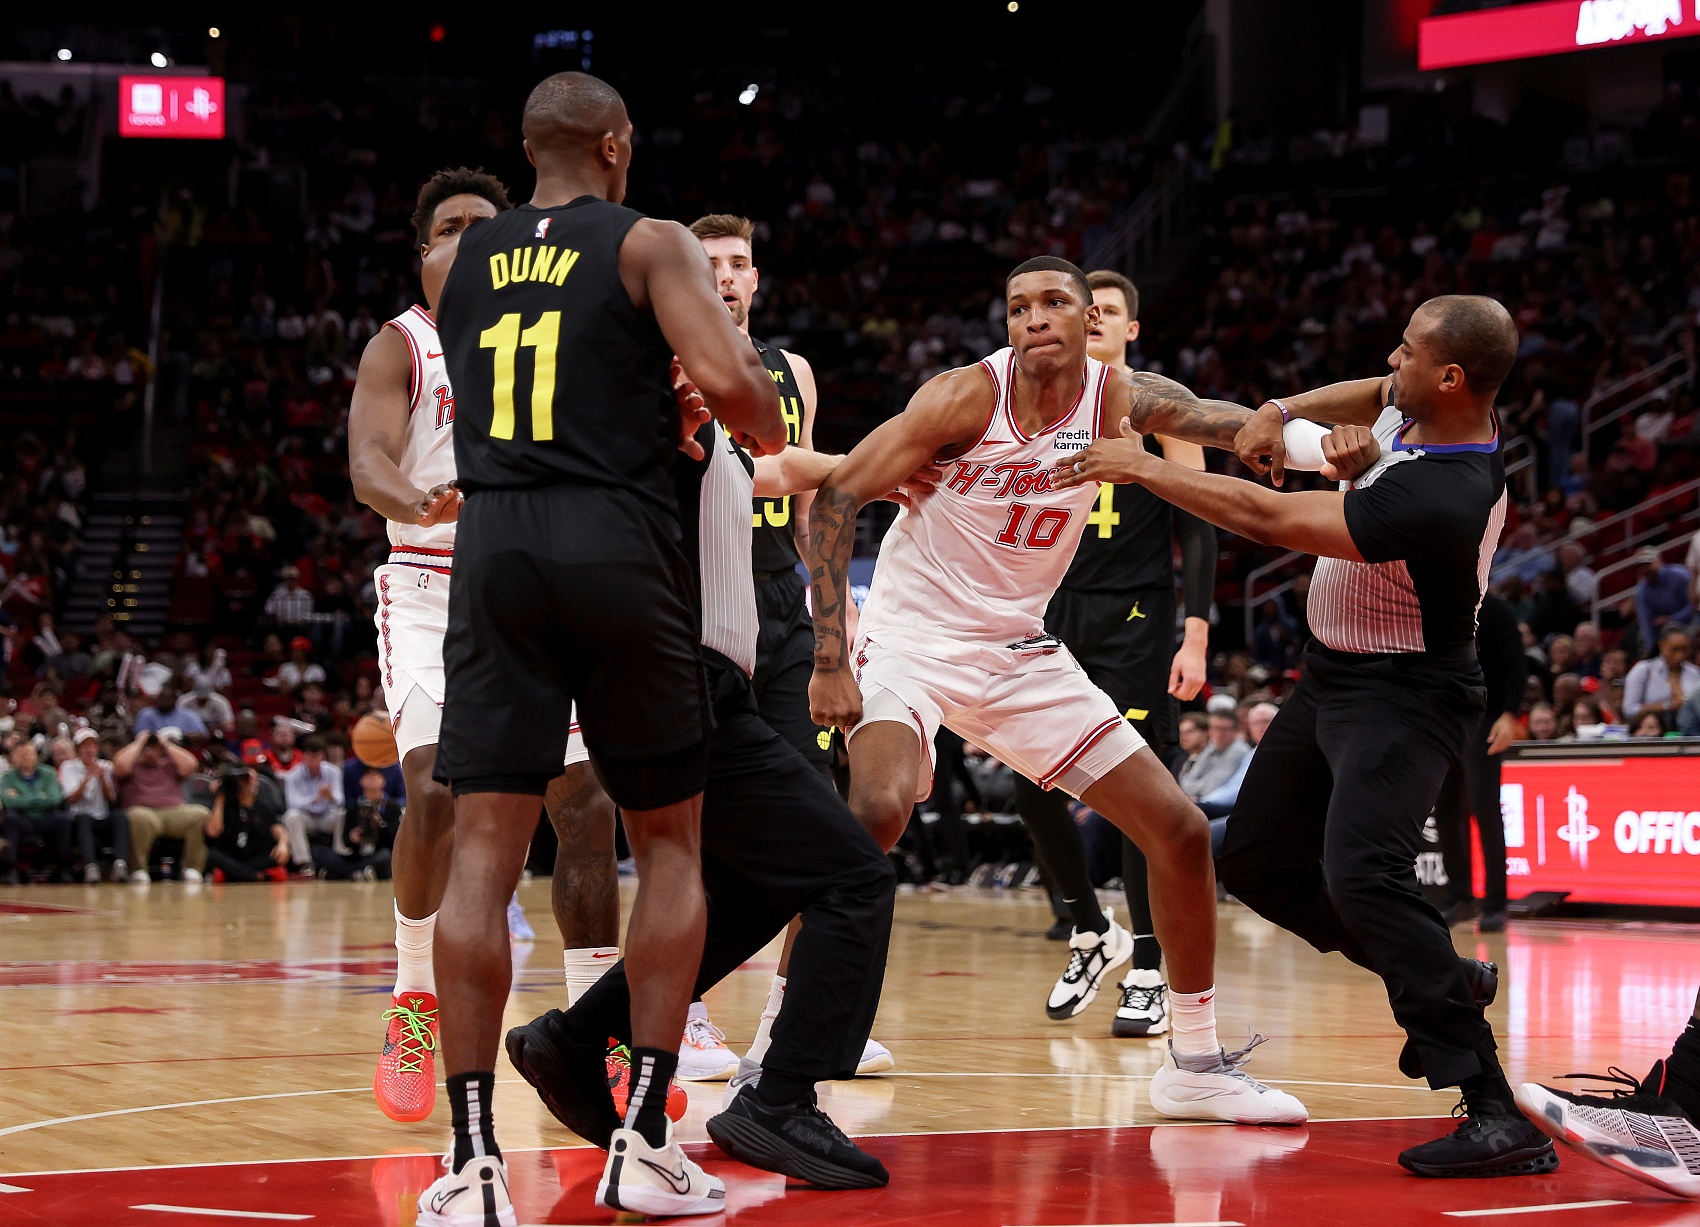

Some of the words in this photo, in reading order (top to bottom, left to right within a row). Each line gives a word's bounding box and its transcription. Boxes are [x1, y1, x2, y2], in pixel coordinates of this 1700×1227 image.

[489, 245, 580, 290] DUNN
[479, 311, 562, 441] 11
[1053, 439, 1090, 451] karma
[1056, 429, 1090, 440] credit
[995, 501, 1073, 550] 10
[1613, 810, 1700, 855] OFFIC
[782, 1118, 833, 1154] HOKA
